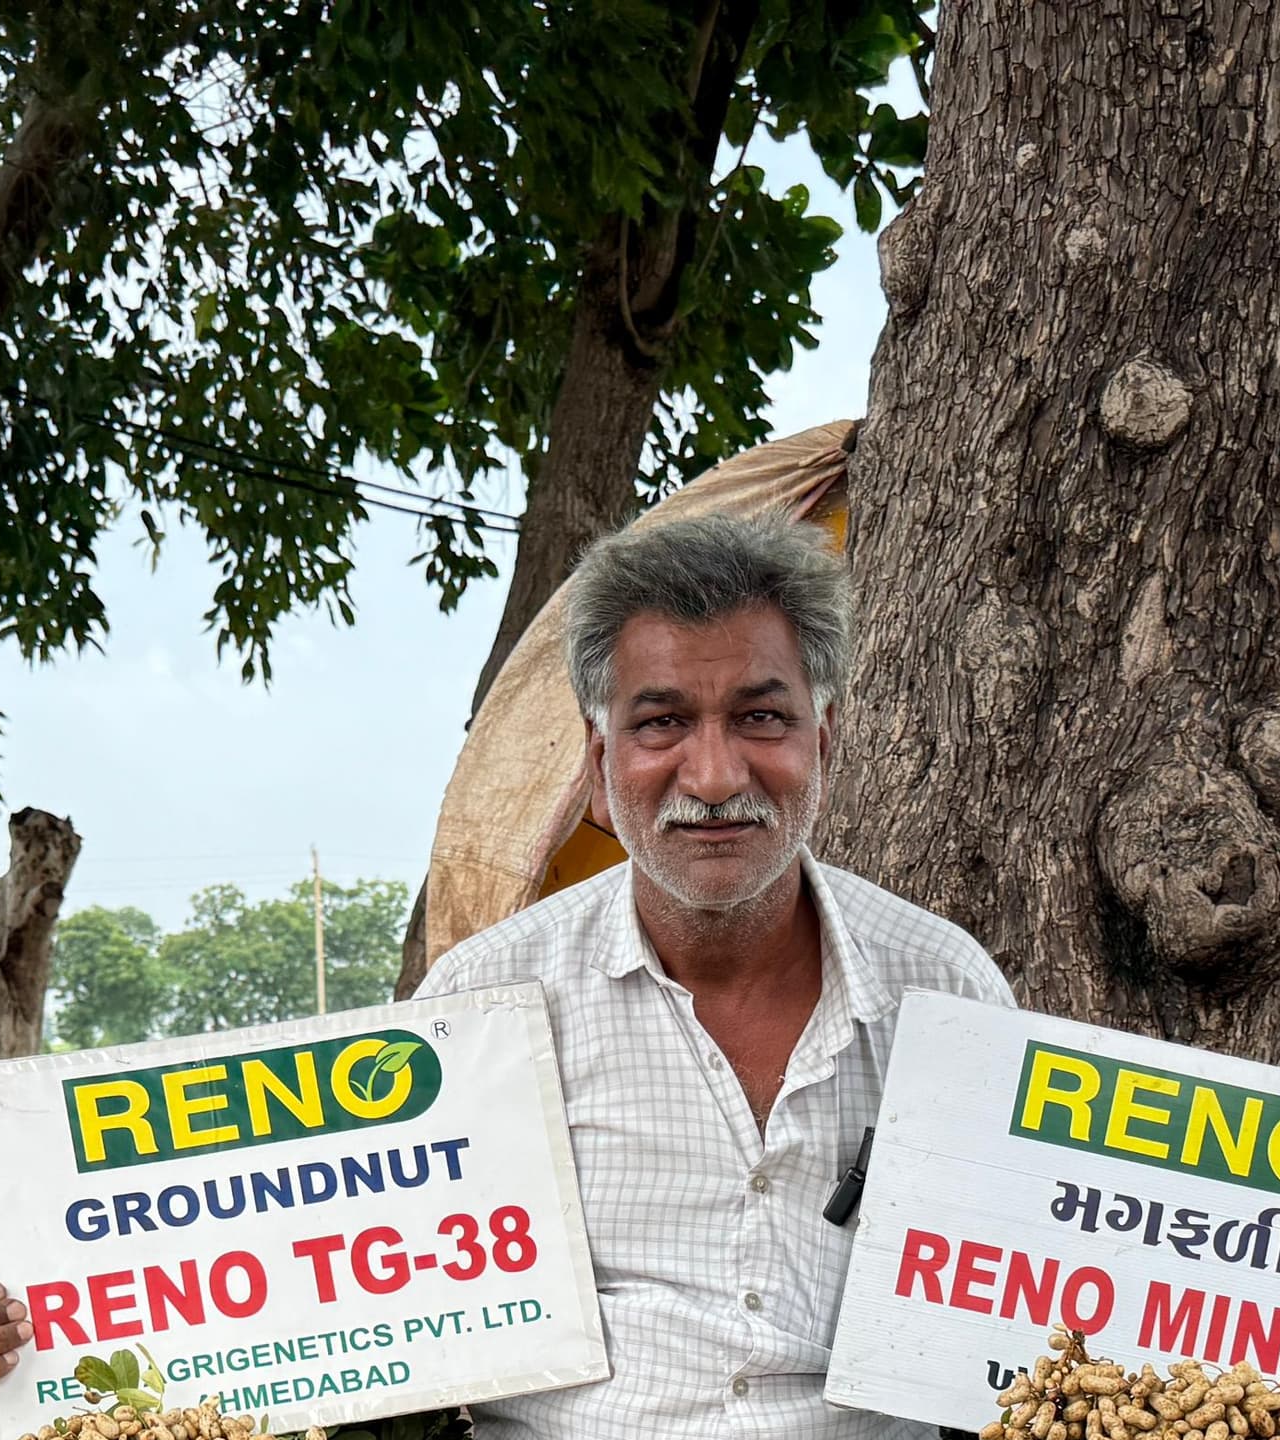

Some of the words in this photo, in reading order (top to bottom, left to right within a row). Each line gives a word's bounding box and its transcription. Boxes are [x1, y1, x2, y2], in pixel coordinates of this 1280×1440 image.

[74, 1037, 422, 1164] RENO
[65, 1138, 470, 1242] GROUNDNUT
[26, 1250, 267, 1352] RENO
[292, 1204, 538, 1304] TG-38
[894, 1228, 1116, 1336] RENO
[146, 1323, 393, 1387] GRIGENETICS
[404, 1310, 473, 1343] PVT.
[482, 1299, 552, 1329] LTD.
[199, 1360, 411, 1415] HMEDABAD
